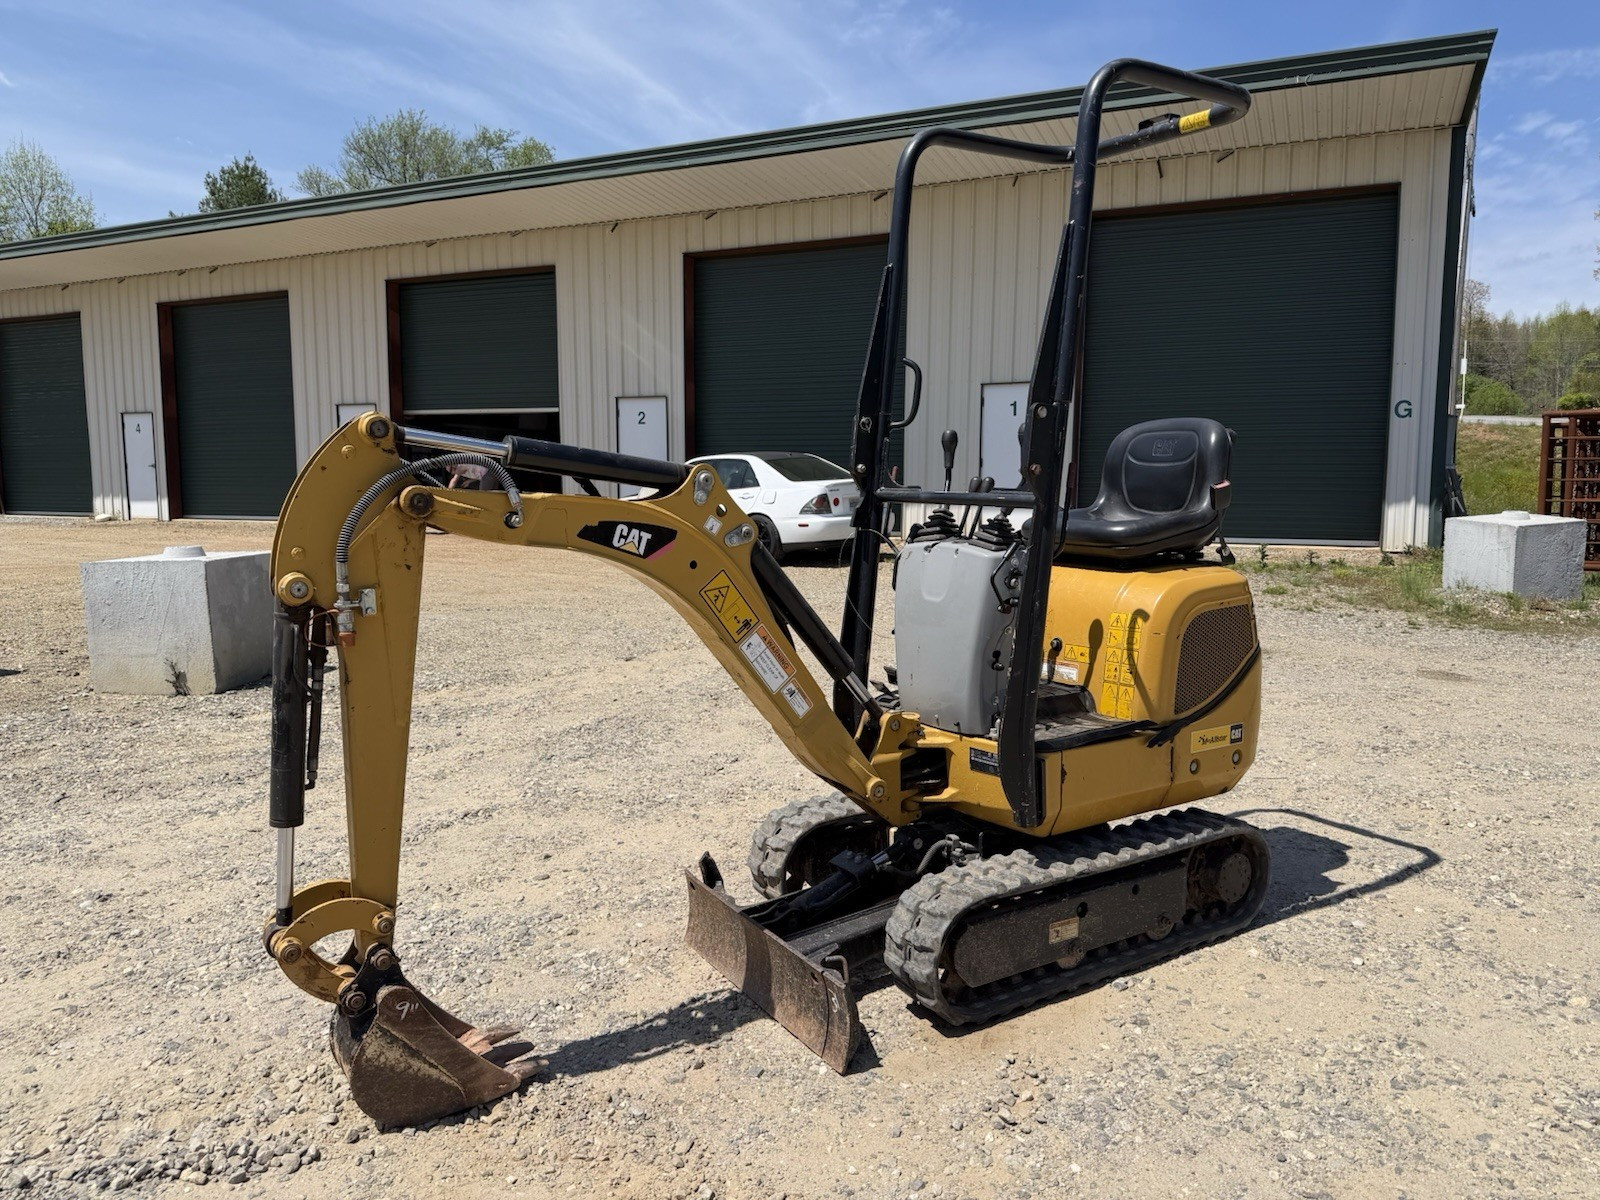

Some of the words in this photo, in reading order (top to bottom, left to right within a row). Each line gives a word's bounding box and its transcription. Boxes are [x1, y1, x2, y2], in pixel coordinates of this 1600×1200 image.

[1010, 401, 1017, 416] 1
[1394, 399, 1412, 418] G
[637, 411, 646, 425] 2
[135, 423, 141, 434] 4
[612, 523, 652, 556] CAT
[766, 640, 789, 669] WARNING
